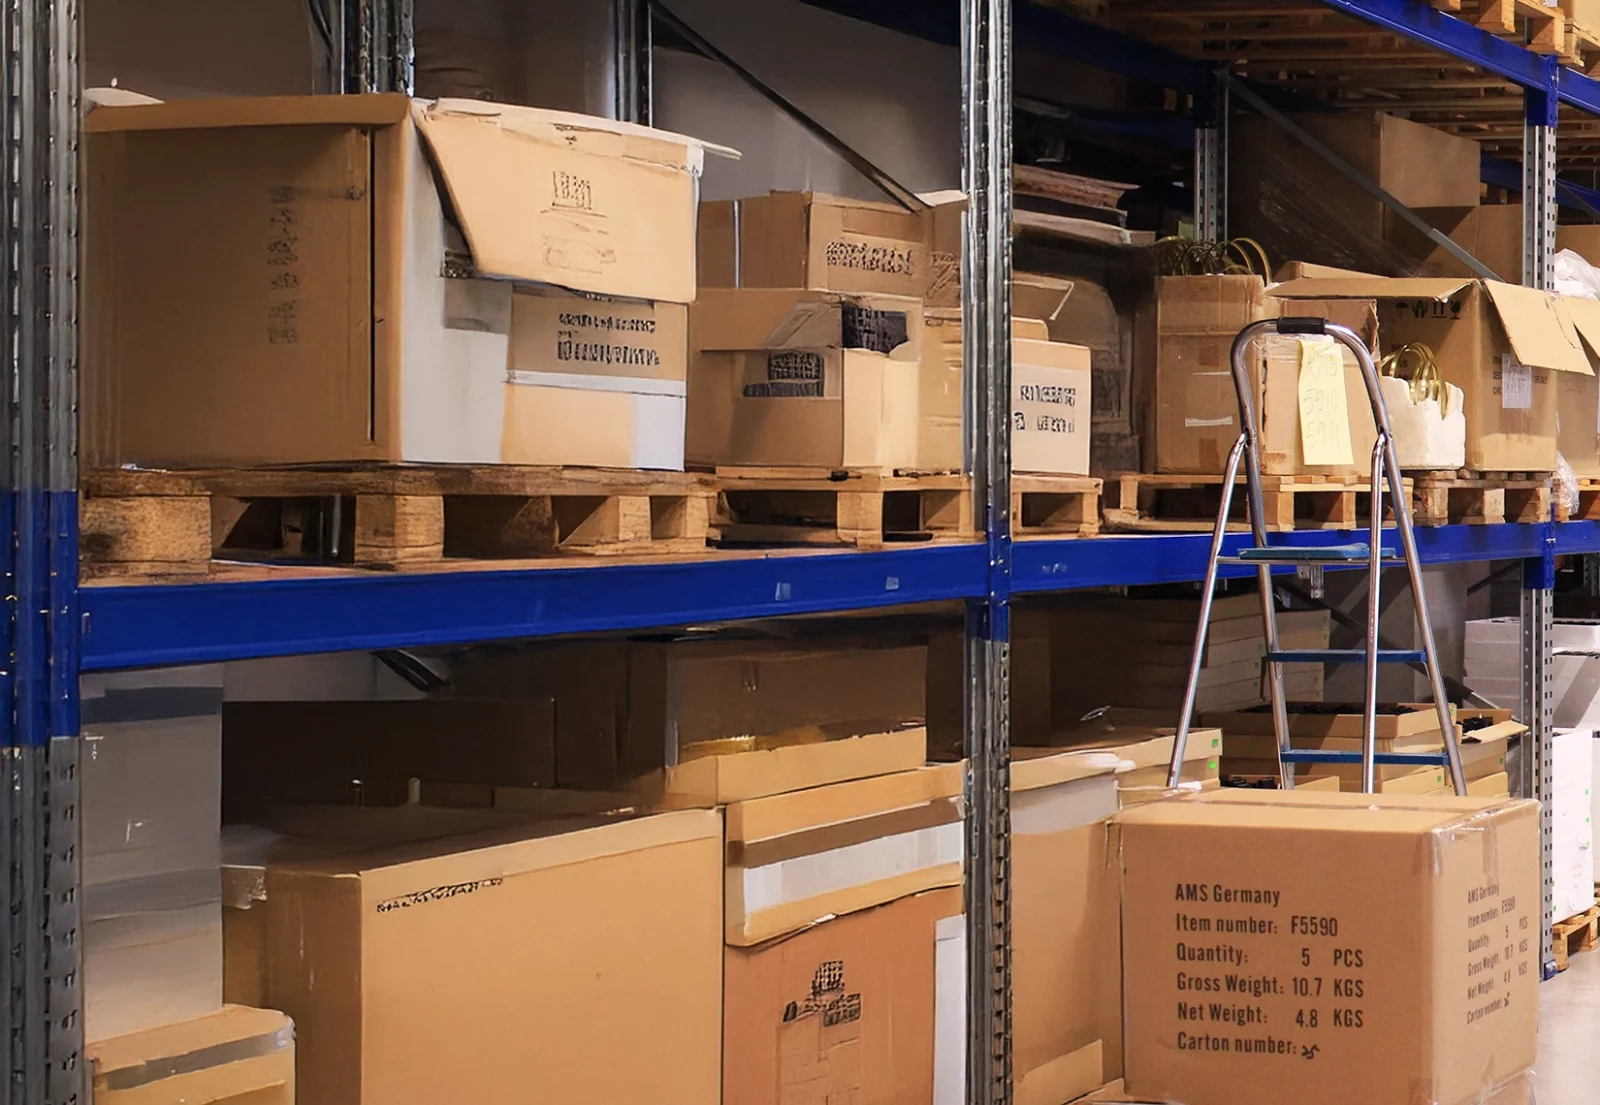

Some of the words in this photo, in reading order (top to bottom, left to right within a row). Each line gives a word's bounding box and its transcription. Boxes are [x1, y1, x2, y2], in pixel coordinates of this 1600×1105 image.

[1175, 883, 1208, 902] AMS
[1213, 884, 1280, 908] Germany
[1468, 888, 1479, 903] AMS
[1479, 884, 1500, 901] Germany
[1176, 913, 1211, 932] Item
[1216, 916, 1278, 934] number:
[1291, 915, 1338, 937] F5590
[1467, 914, 1480, 928] Item
[1519, 916, 1528, 930] PCS
[1176, 942, 1248, 966] Quantity:
[1301, 948, 1311, 967] 5
[1333, 949, 1364, 968] PCS
[1177, 972, 1221, 992] Gross
[1225, 974, 1284, 997] Weight:
[1292, 977, 1323, 997] 10.7
[1334, 979, 1364, 998] KGS
[1177, 1002, 1204, 1021] Net
[1209, 1003, 1268, 1026] Weight:
[1295, 1009, 1318, 1028] 4.8
[1333, 1009, 1364, 1028] KGS
[1177, 1031, 1230, 1051] Carton
[1235, 1036, 1297, 1055] number:
